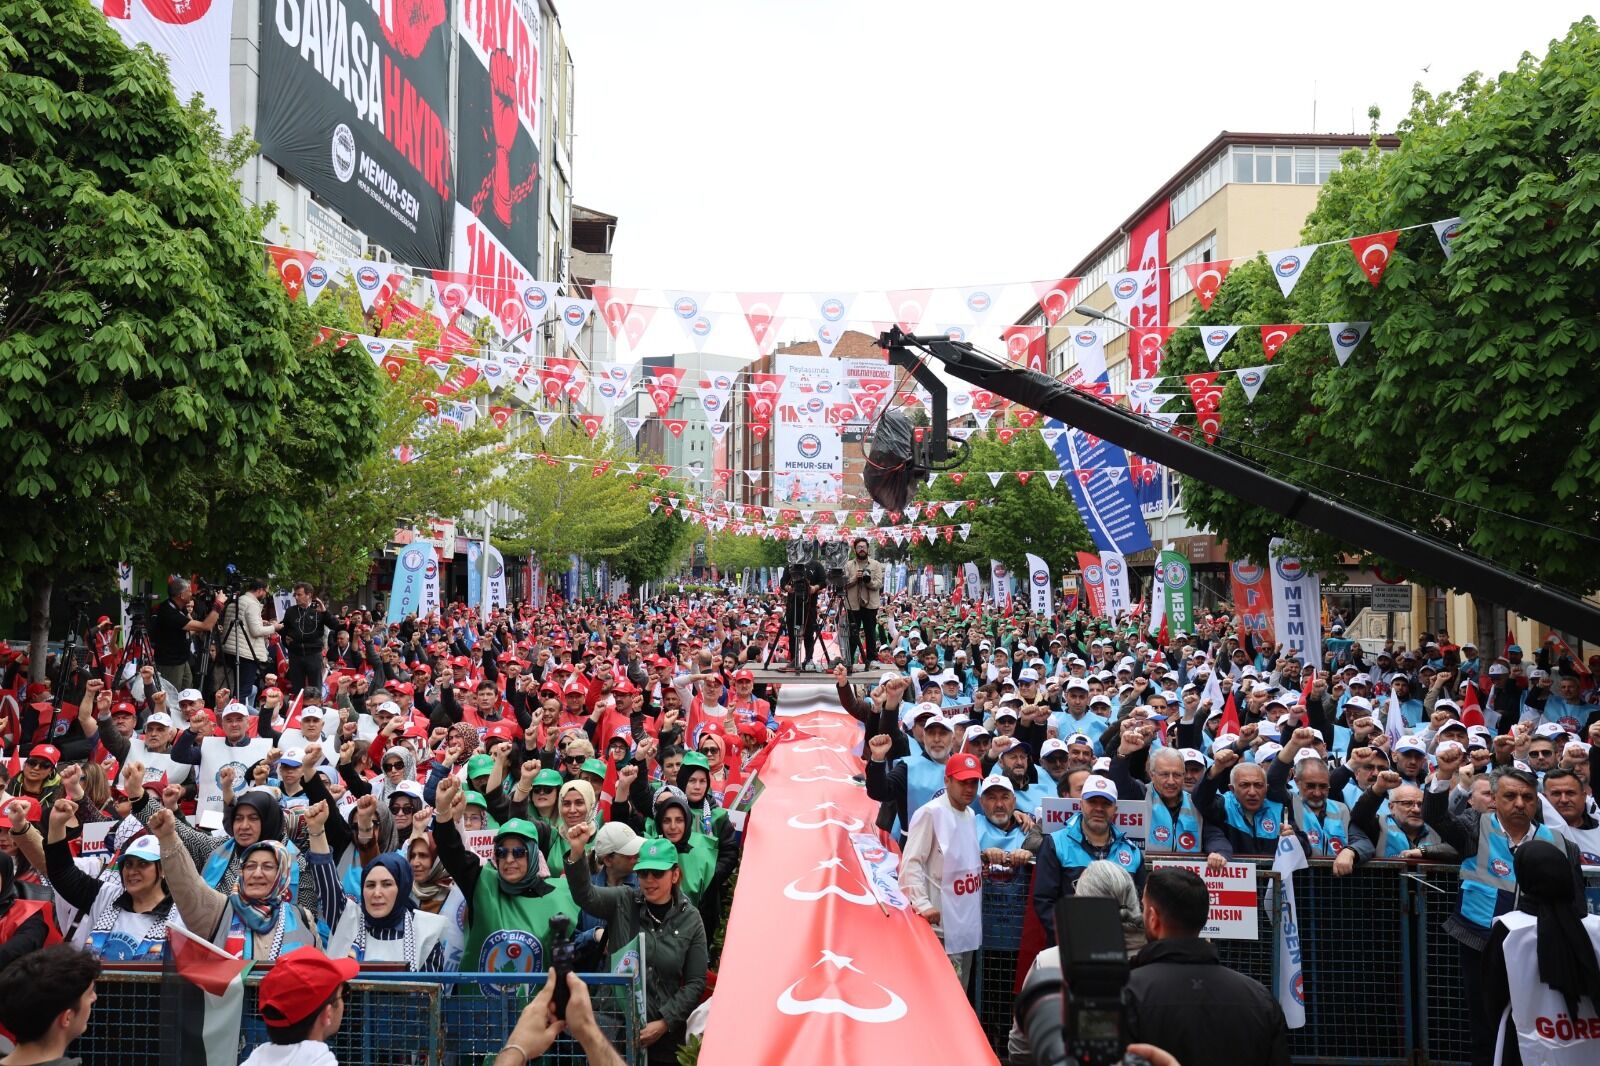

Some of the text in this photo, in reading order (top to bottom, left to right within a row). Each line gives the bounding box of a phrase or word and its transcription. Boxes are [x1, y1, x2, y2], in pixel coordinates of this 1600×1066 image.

[384, 54, 449, 201] HAYIR!
[359, 151, 419, 222] MEMUR-SEN
[785, 461, 833, 470] MEMUR-SEN
[1205, 866, 1248, 879] ADALET
[1207, 909, 1242, 921] INSIN
[509, 931, 540, 955] BİR-SEN
